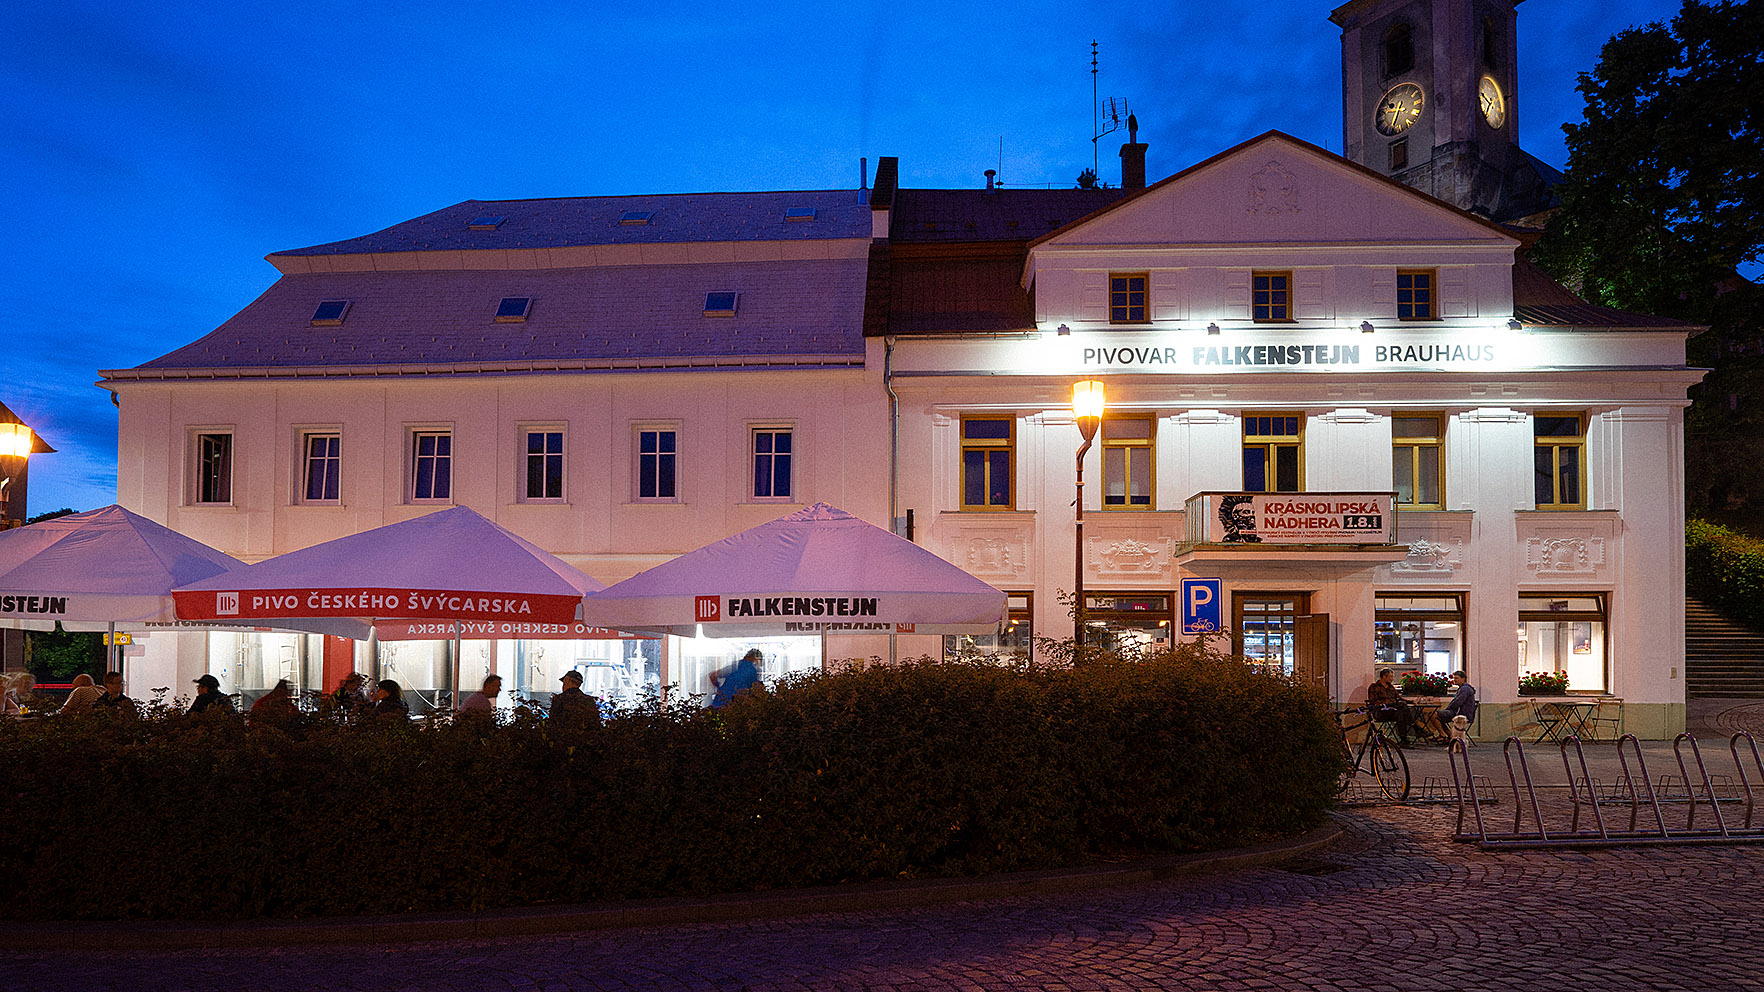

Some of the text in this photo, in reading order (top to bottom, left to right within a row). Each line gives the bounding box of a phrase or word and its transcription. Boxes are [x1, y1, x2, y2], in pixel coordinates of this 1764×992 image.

[1084, 345, 1494, 365] PIVOVAR FALKENSTEJN BRAUHAUS
[1264, 499, 1381, 515] KRÁSNOLIPSKÁ
[1264, 514, 1341, 529] NÁDHERA
[0, 595, 66, 614] STEJN
[253, 591, 532, 614] PIVO ČESKÉHO ŠVÝCARSKA
[728, 597, 877, 617] FALKENSTEJN
[1190, 585, 1213, 617] P
